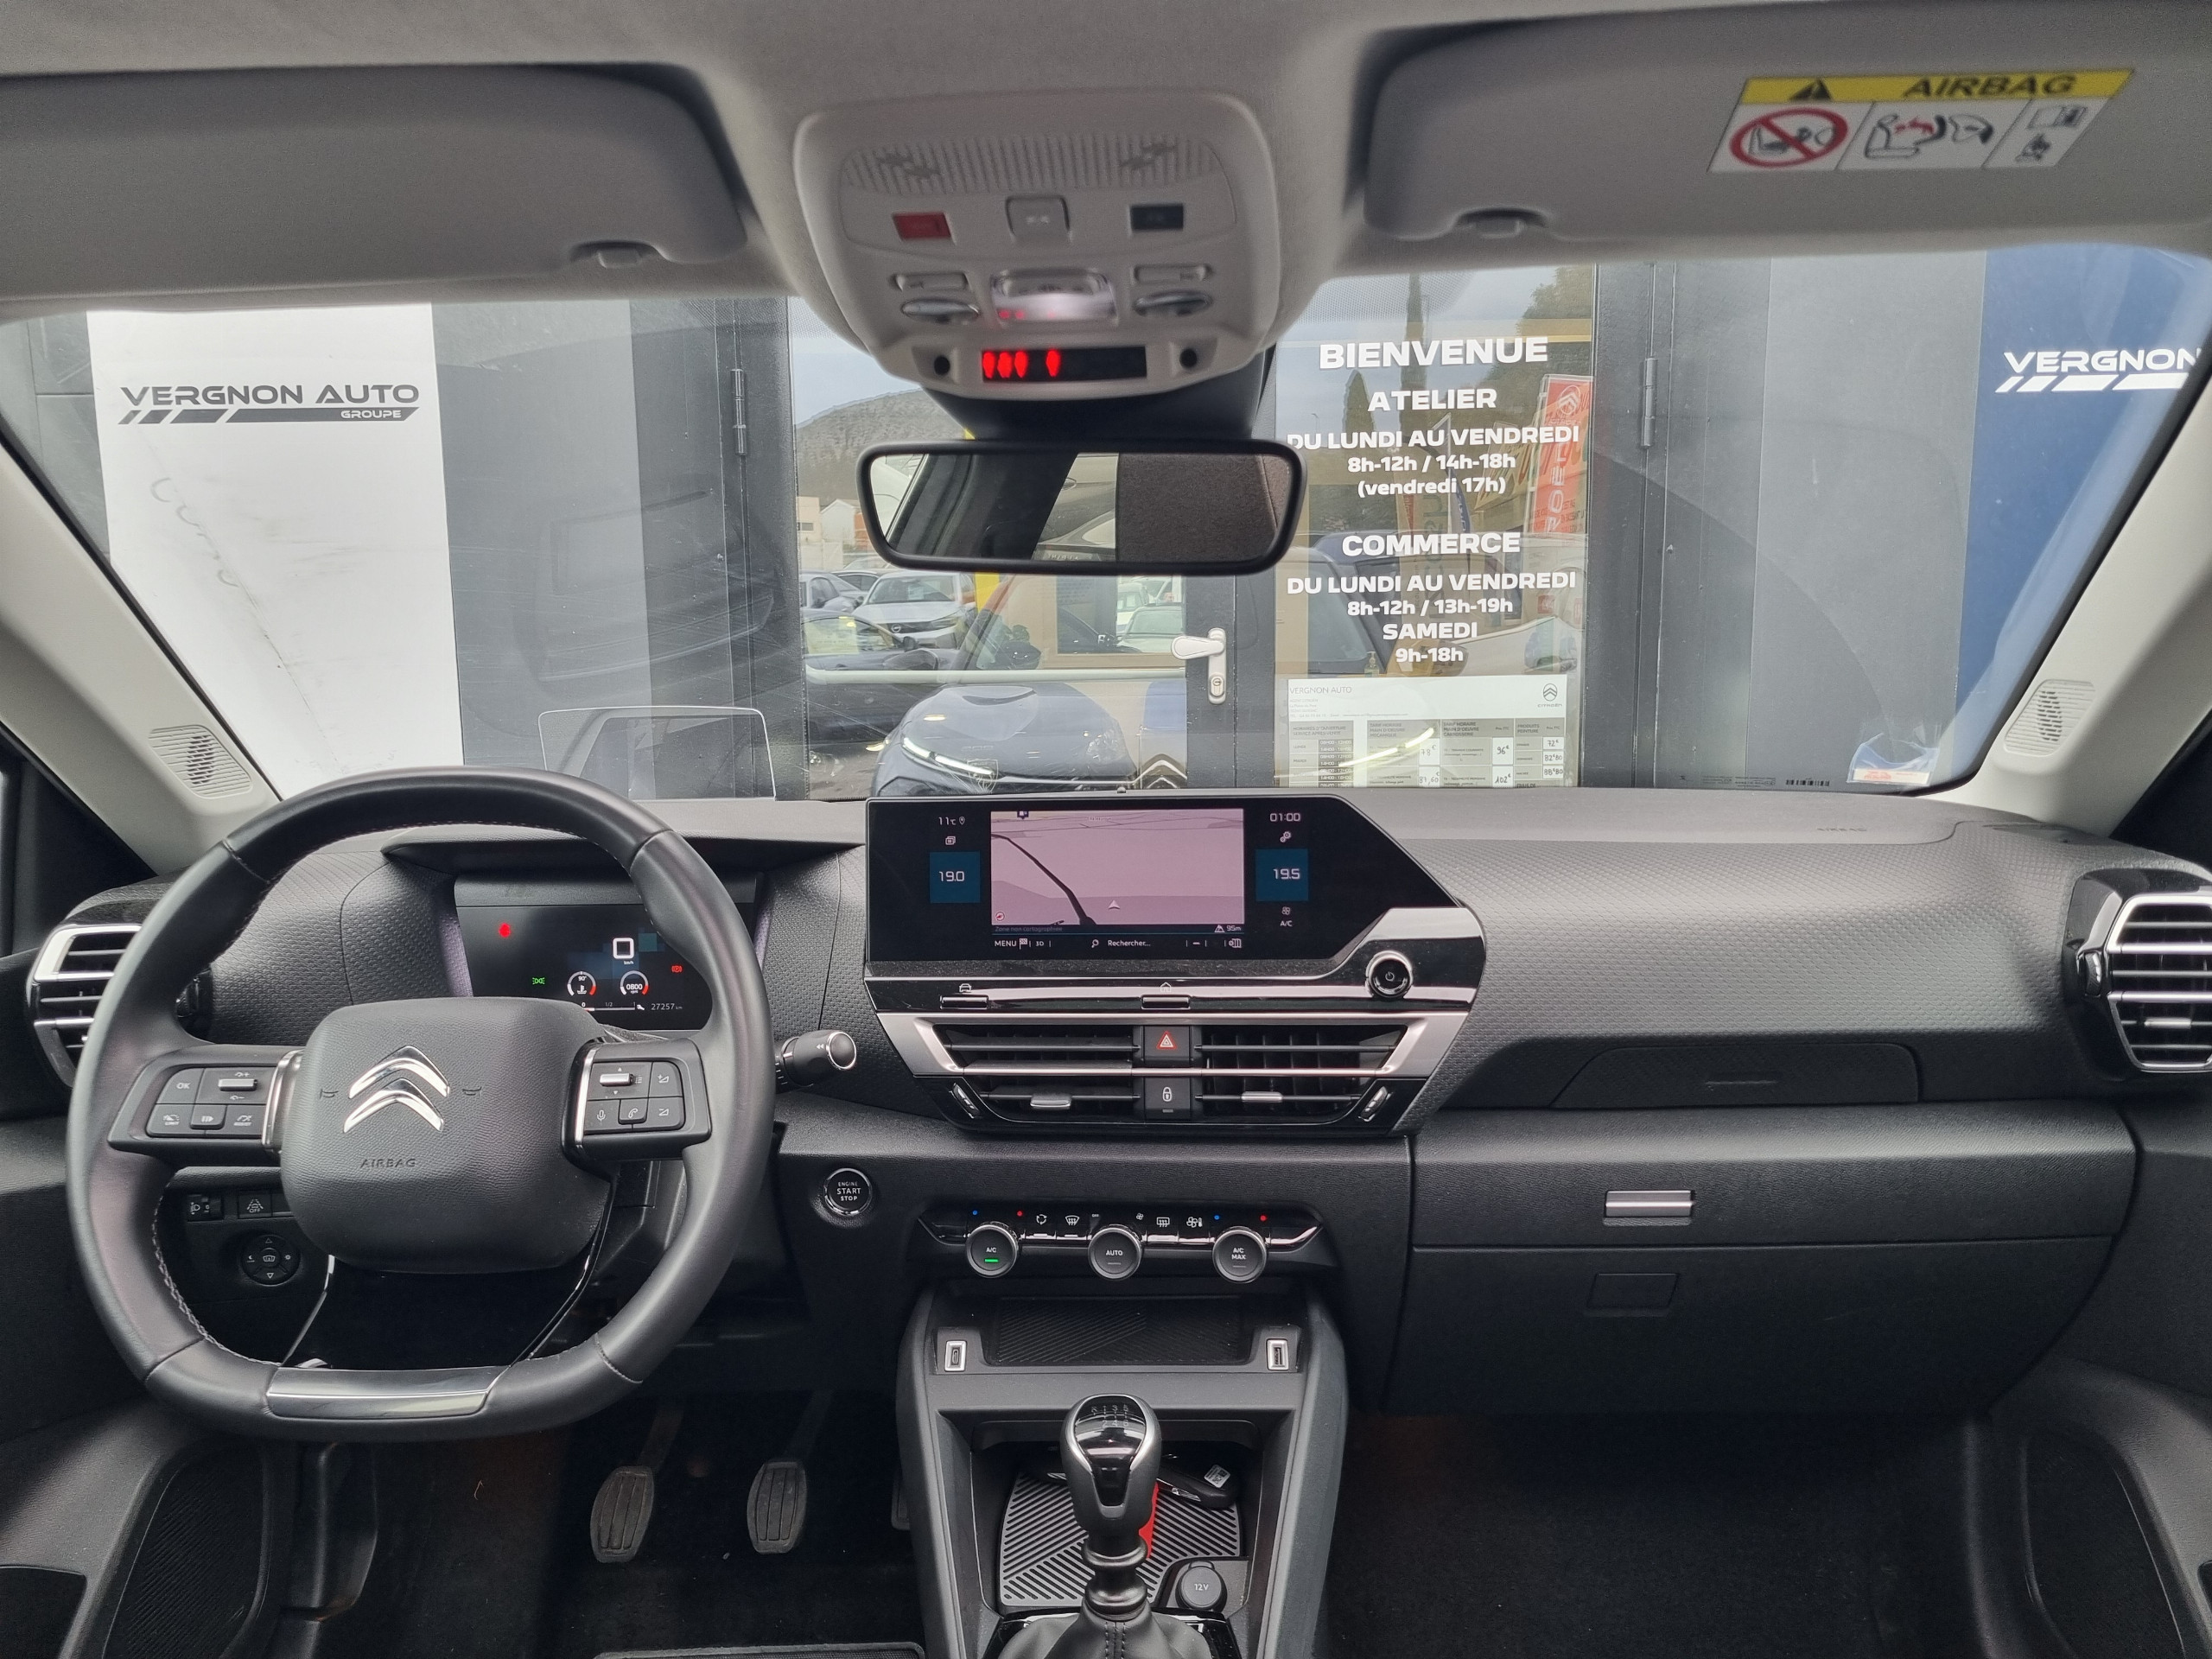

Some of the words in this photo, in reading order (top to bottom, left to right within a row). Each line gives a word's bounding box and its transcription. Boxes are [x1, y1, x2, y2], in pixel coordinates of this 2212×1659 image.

[1902, 75, 2075, 98] AIRBAG
[1319, 337, 1548, 369] BIENVENUE
[2004, 347, 2202, 373] VERGNON
[121, 385, 302, 406] VERGNON
[315, 385, 419, 404] AUTO
[1368, 389, 1497, 411] ATELIER
[340, 410, 401, 419] GROUPE
[1287, 433, 1321, 450] DU
[1328, 430, 1402, 449] LUNDI
[1408, 429, 1445, 447] AU
[1451, 426, 1579, 446] VENDREDI
[1347, 456, 1417, 474] 8h-12h
[1422, 455, 1431, 473] /
[1435, 454, 1516, 470] 14h-18h
[1357, 477, 1456, 498] (vendredi
[1461, 476, 1506, 495] 17h)
[1342, 532, 1520, 556] COMMERCE
[1287, 577, 1321, 594] DU
[1328, 576, 1401, 593] LUNDI
[1407, 575, 1443, 591] AU
[1448, 572, 1576, 590] VENDREDI
[1347, 601, 1414, 616] 8h-12h
[1420, 600, 1428, 616] /
[1434, 598, 1512, 614] 13h-19h
[1382, 622, 1478, 640] SAMEDI
[1395, 647, 1463, 663] 9h-18h
[1269, 813, 1300, 822] 01:00
[939, 871, 965, 882] 19.0
[1274, 868, 1300, 880] 19.5
[359, 1158, 416, 1168] AIRBAG
